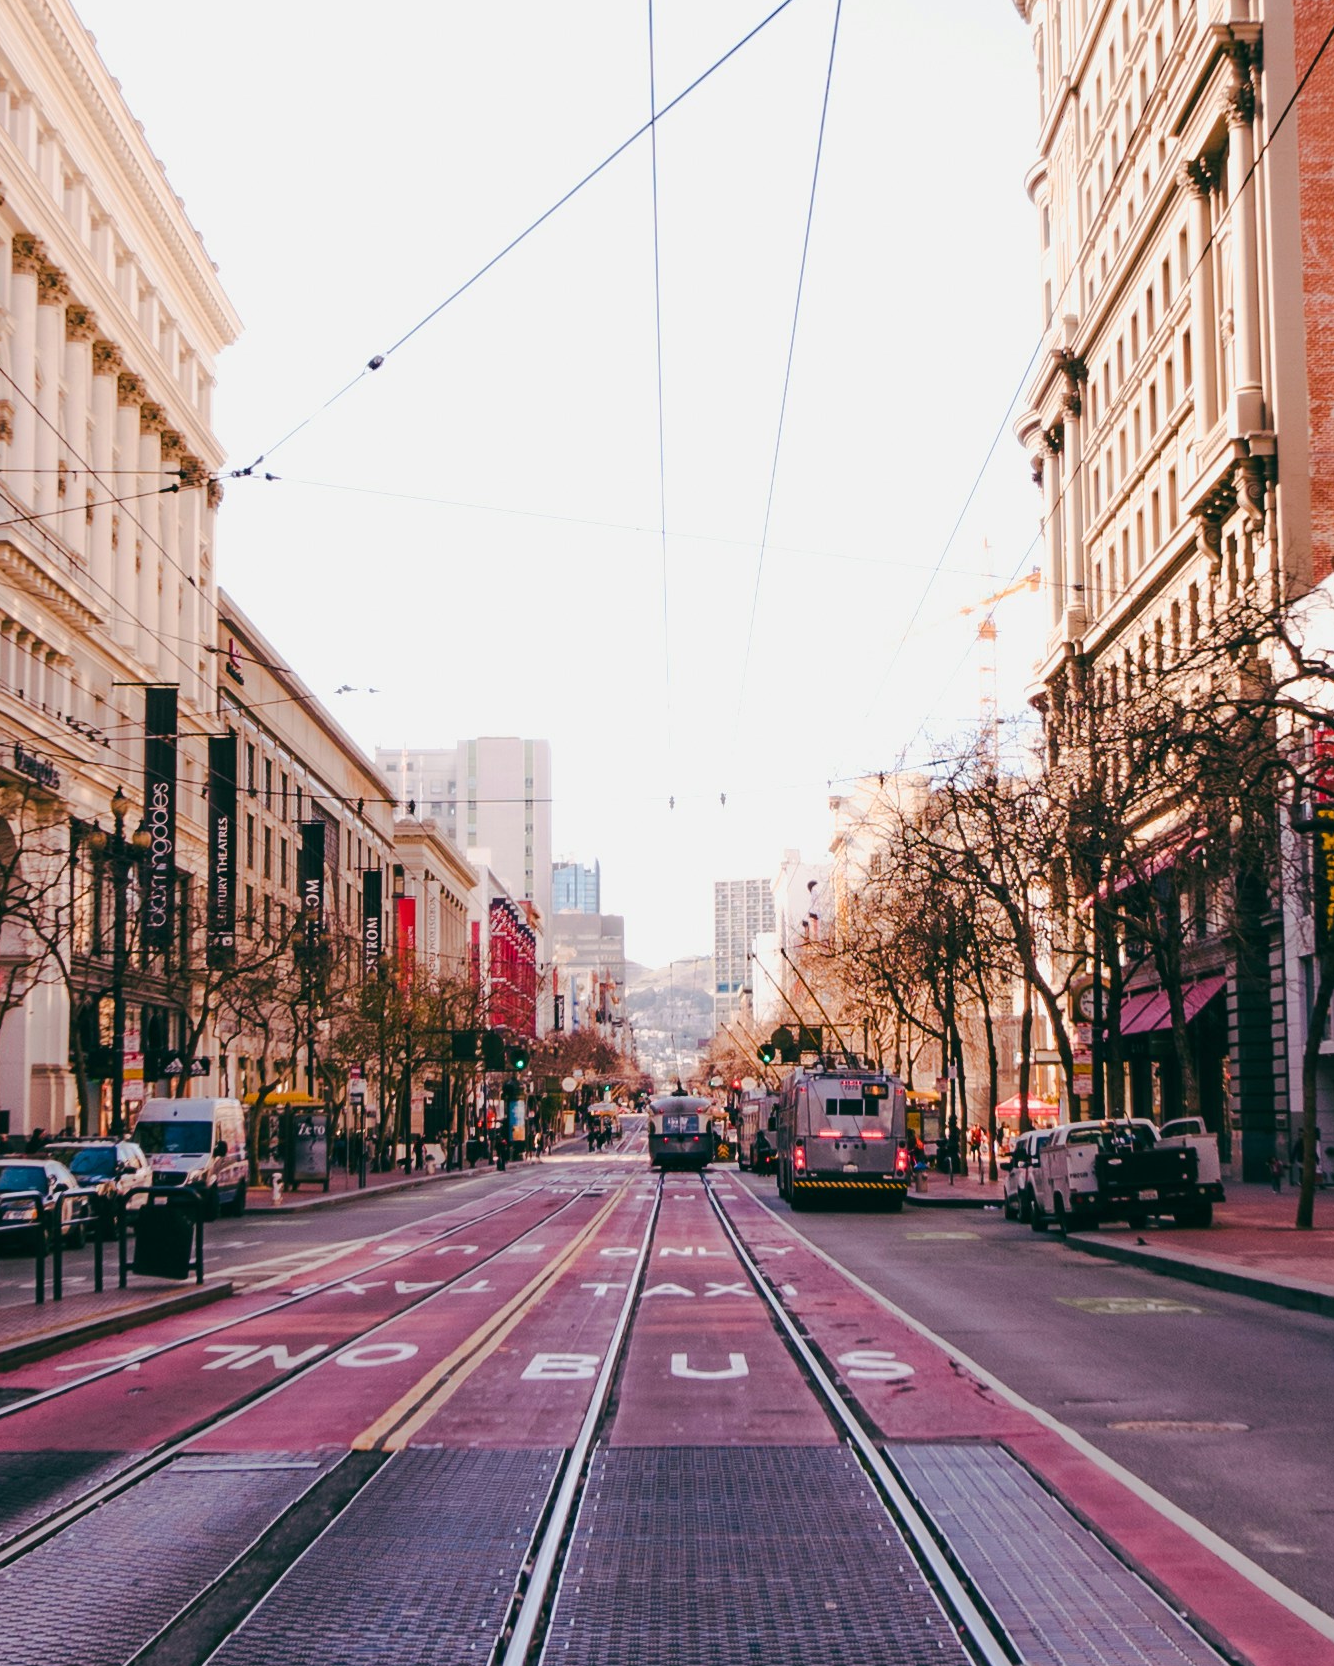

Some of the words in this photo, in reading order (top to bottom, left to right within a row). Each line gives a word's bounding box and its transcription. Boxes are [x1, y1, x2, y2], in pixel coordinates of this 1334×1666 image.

[147, 782, 172, 927] bloomngdales
[217, 815, 229, 873] THEATRES
[599, 1245, 795, 1257] ONLY
[580, 1282, 798, 1298] TAXI
[520, 1350, 916, 1381] BUS
